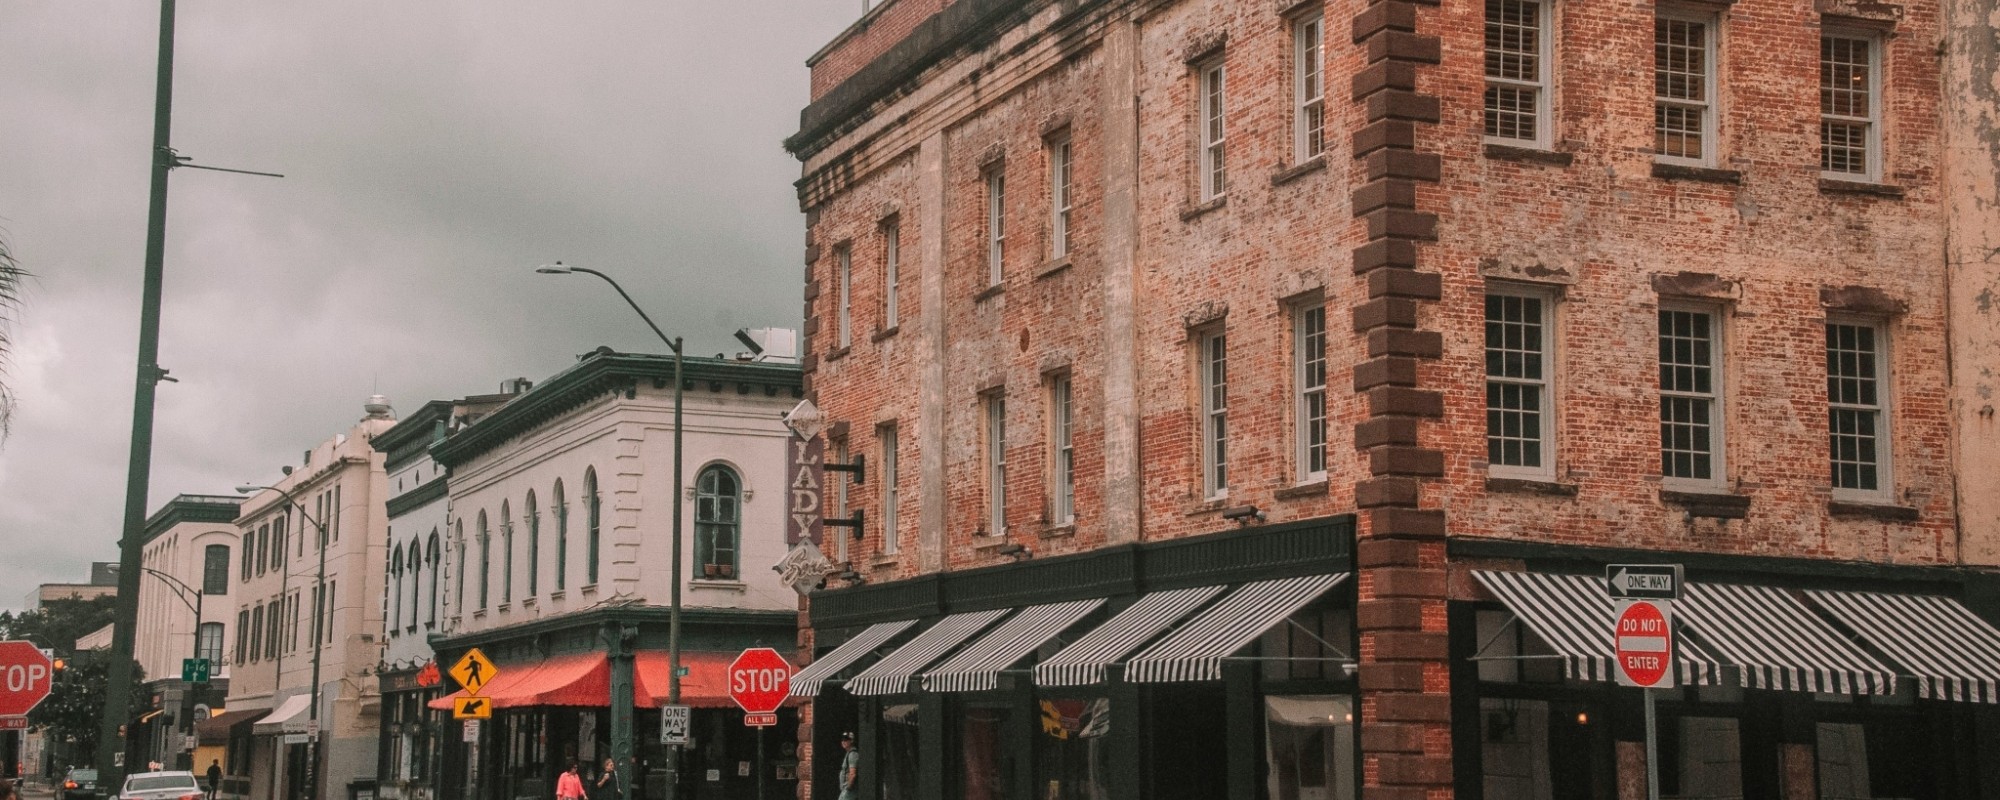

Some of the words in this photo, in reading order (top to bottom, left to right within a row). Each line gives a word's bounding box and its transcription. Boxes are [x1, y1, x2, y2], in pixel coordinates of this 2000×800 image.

[792, 441, 818, 538] LADY
[1627, 575, 1646, 588] ONE
[1648, 576, 1668, 589] WAY
[1623, 619, 1637, 632] DO
[1641, 619, 1662, 632] NOT
[1627, 656, 1659, 670] ENTER
[0, 663, 46, 692] OP
[733, 668, 786, 693] STOP
[665, 708, 687, 717] ONE
[7, 719, 25, 727] WAY
[664, 718, 687, 728] WAY
[747, 716, 759, 724] ALL
[762, 716, 775, 724] WAY
